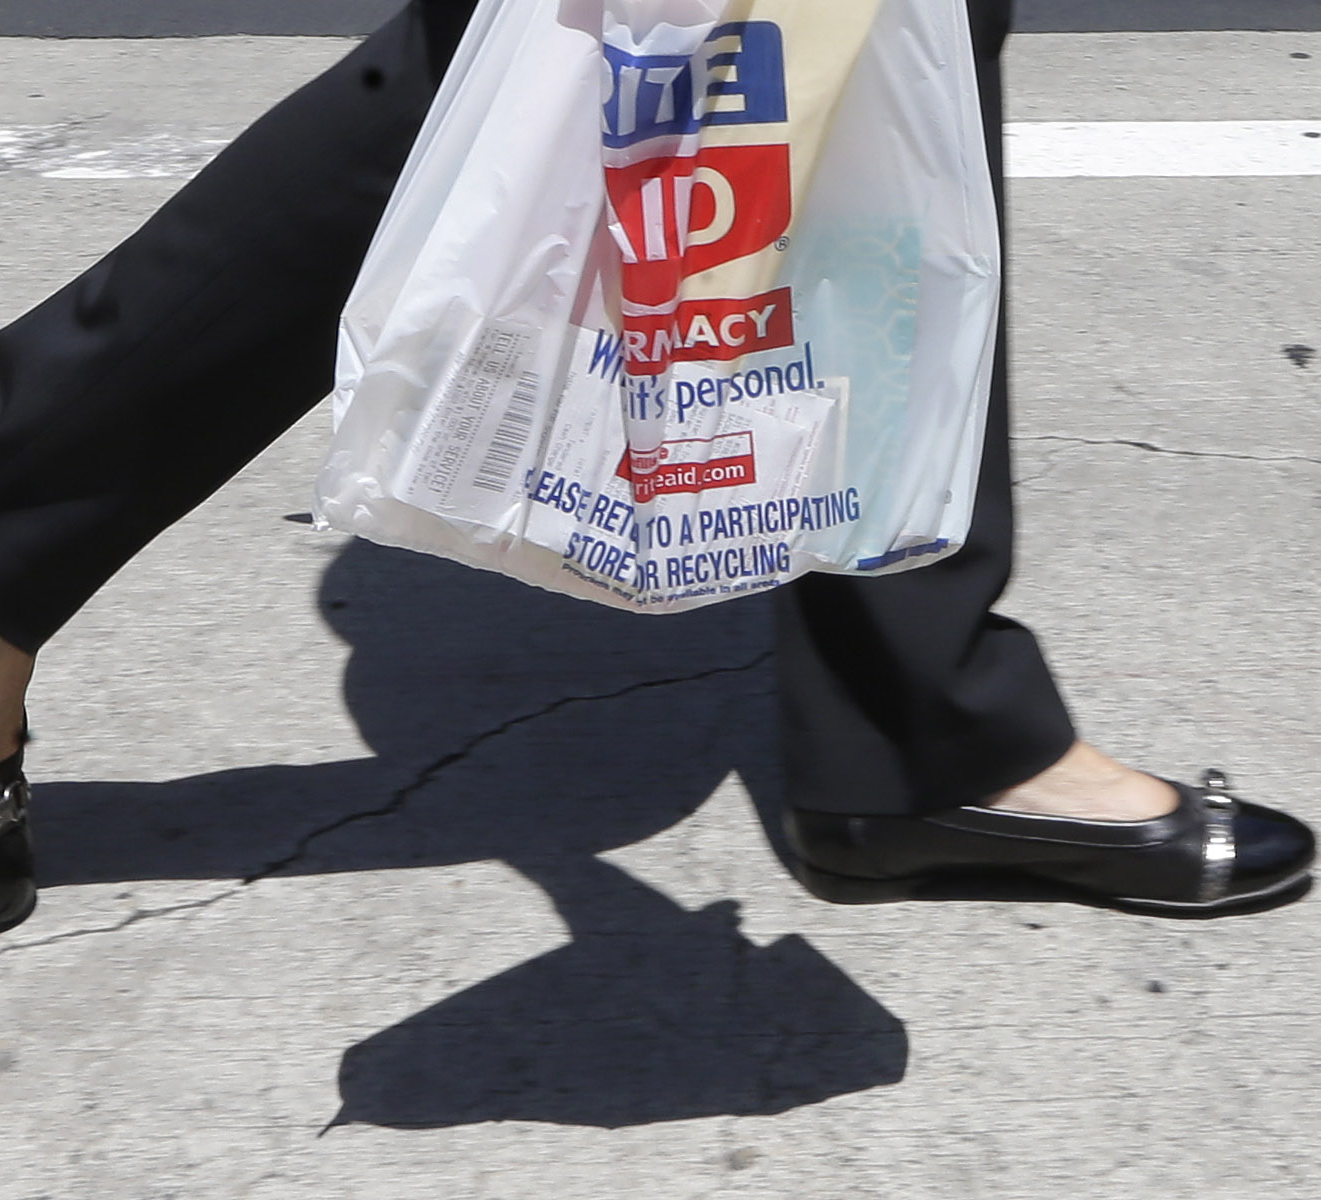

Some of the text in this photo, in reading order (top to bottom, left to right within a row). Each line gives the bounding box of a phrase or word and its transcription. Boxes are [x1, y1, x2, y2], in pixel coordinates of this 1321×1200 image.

[468, 377, 491, 411] ABOUT
[630, 375, 665, 420] it's
[677, 341, 825, 423] personal.
[453, 415, 477, 442] YOUR
[635, 464, 745, 495] riteaid.com
[679, 513, 694, 547] A
[699, 486, 861, 543] PARTICIPATING
[563, 532, 636, 583] STORE
[667, 542, 791, 590] RECYCLING
